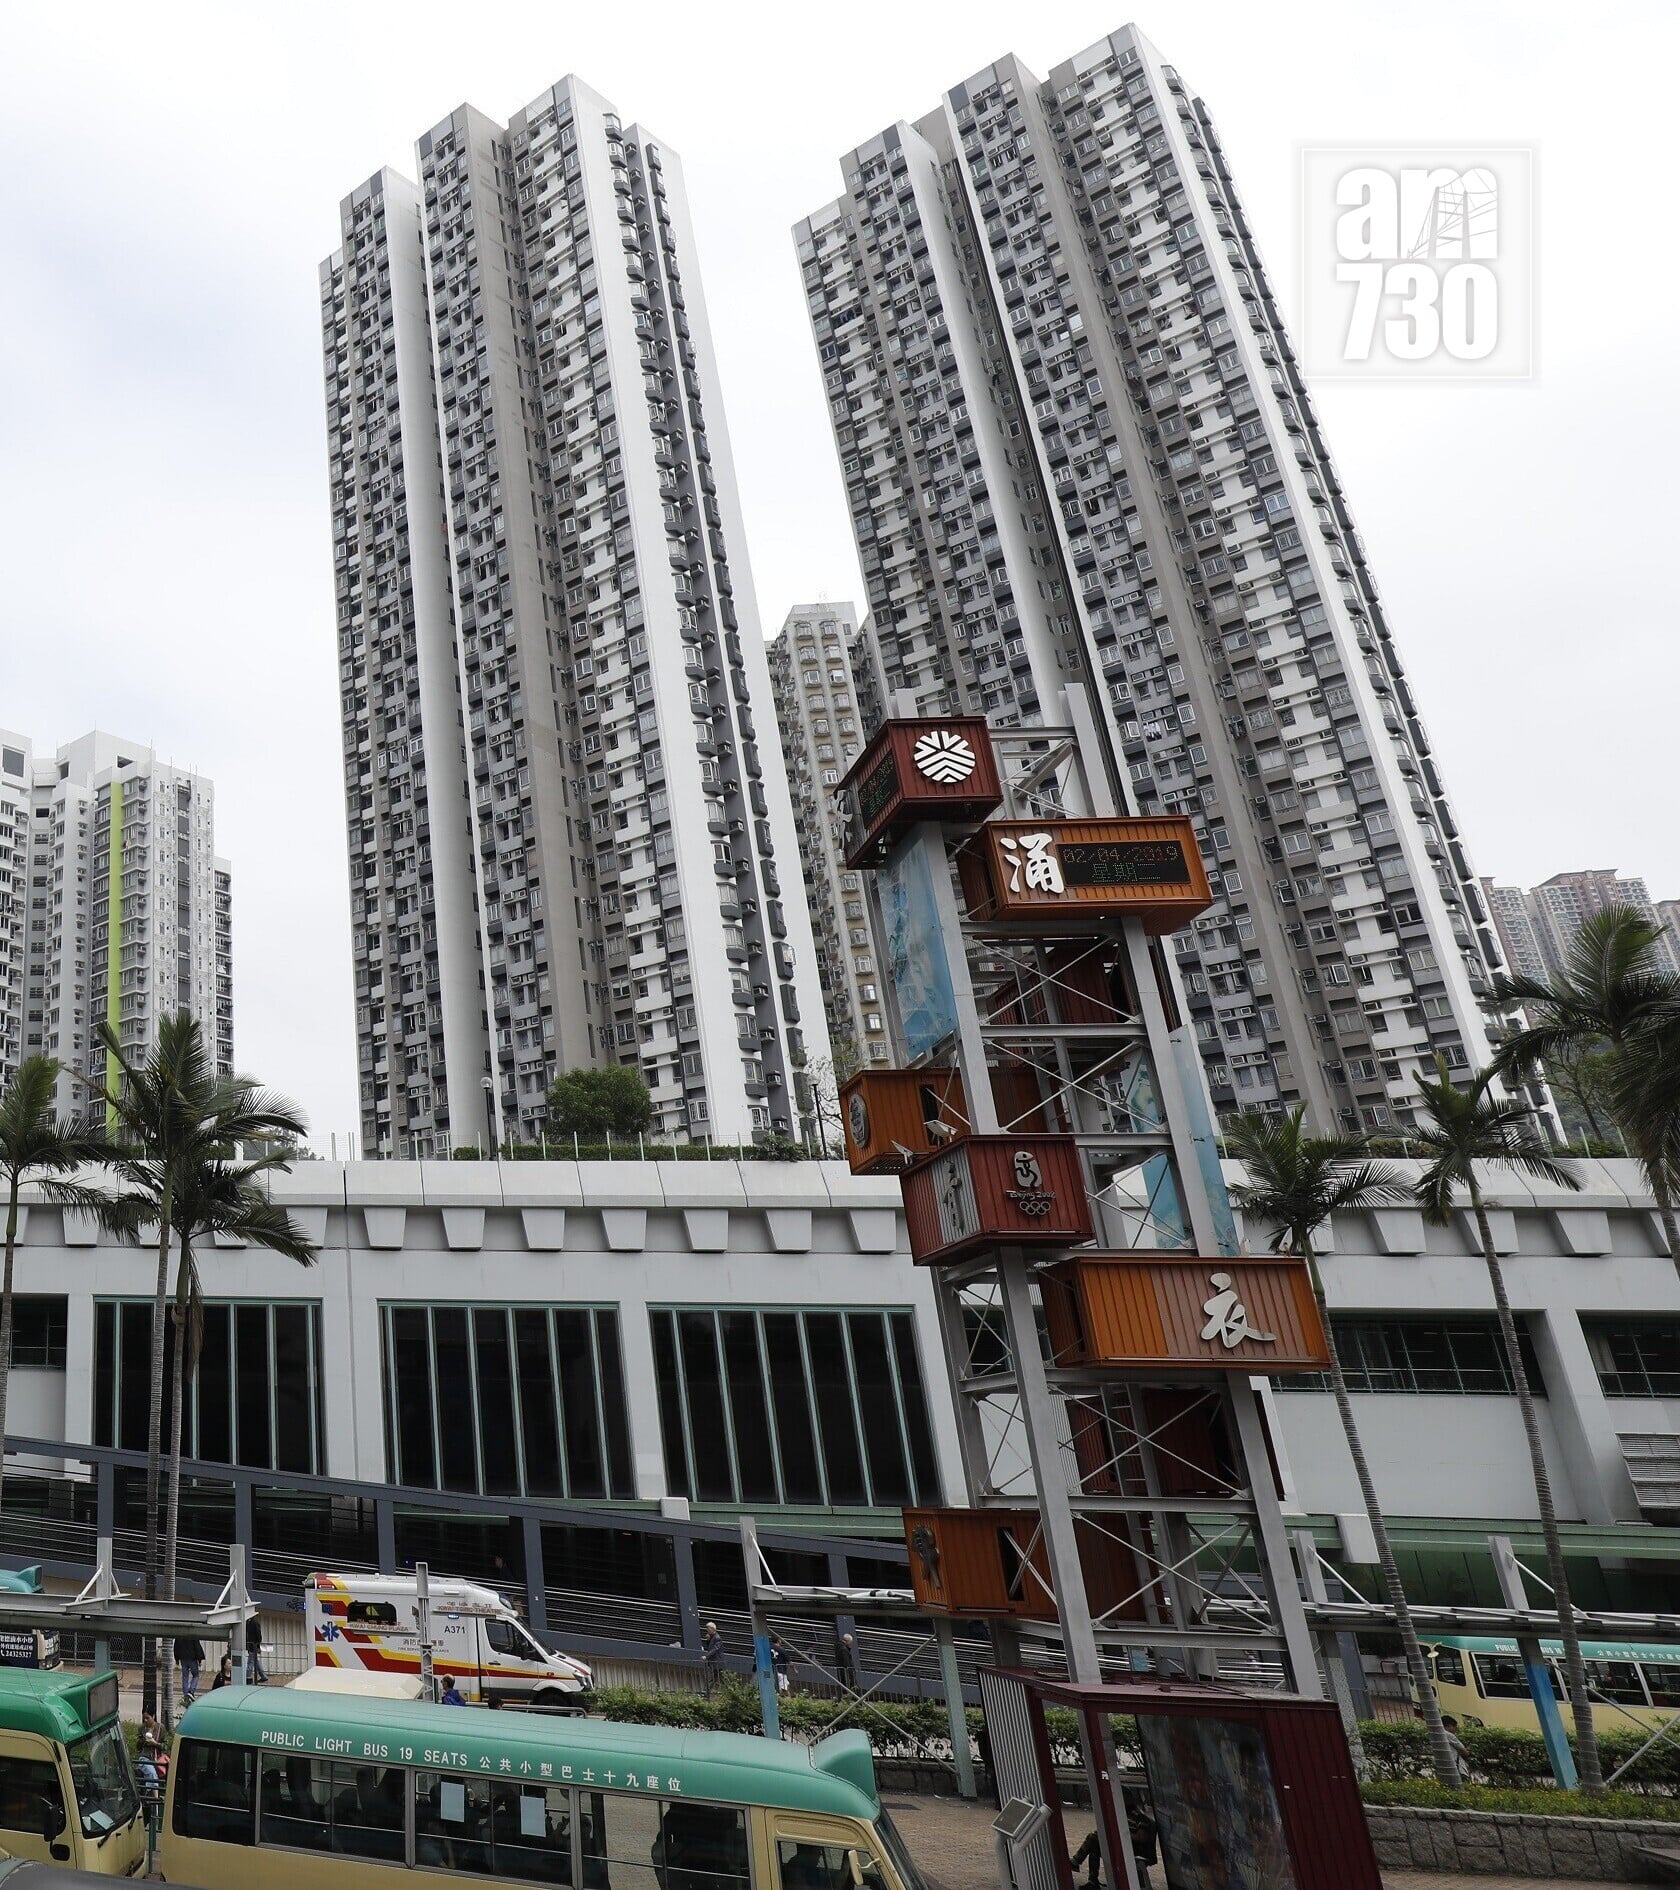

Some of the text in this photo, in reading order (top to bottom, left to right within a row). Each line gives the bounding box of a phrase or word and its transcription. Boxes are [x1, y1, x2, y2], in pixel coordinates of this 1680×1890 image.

[1063, 846, 1178, 863] 02/04/2019
[1000, 833, 1064, 894] 涌
[1092, 862, 1161, 882] 星期二
[1006, 1190, 1035, 1200] Beijing
[444, 1625, 466, 1634] A371
[1495, 1644, 1518, 1652] PUBLIC
[261, 1730, 681, 1792] PUBLIC LIGHT BUS 19 SEATS 公共小型巴士十九座位
